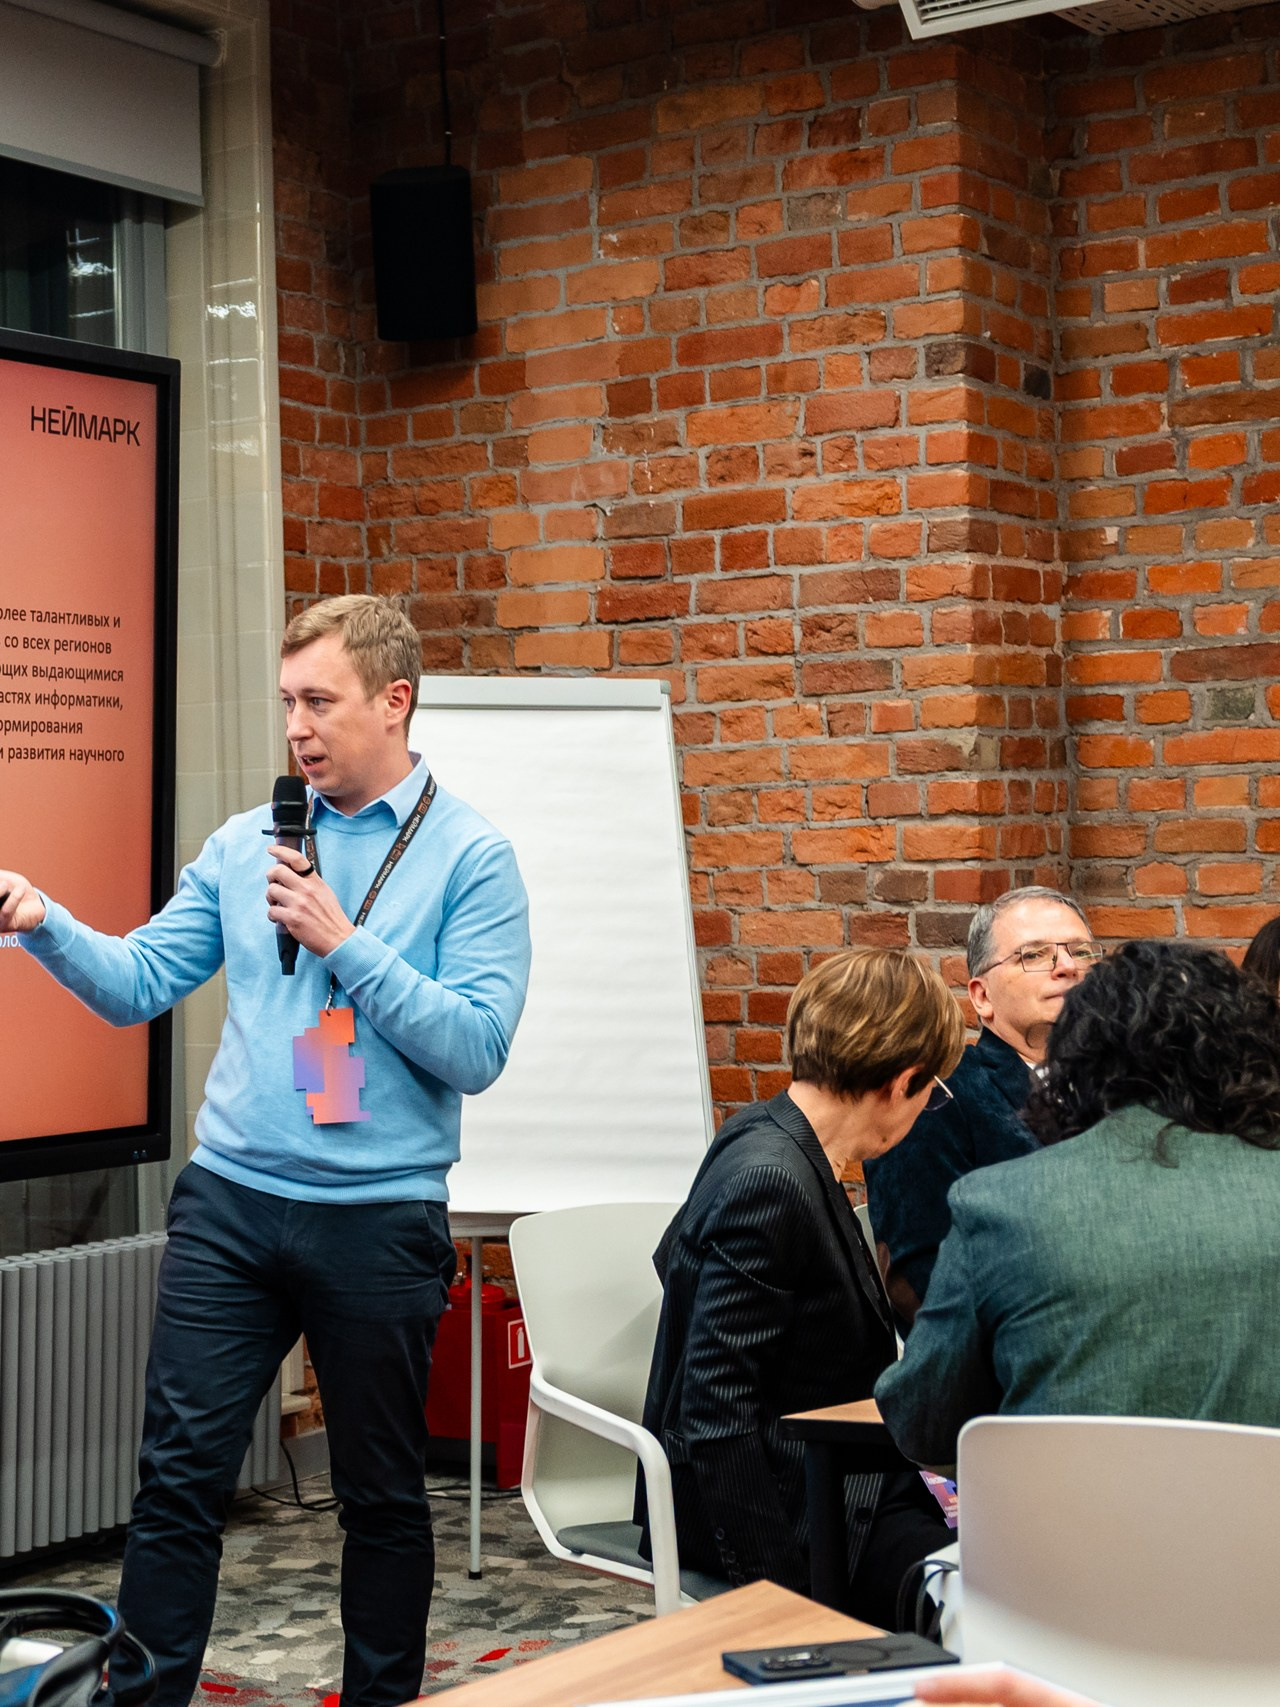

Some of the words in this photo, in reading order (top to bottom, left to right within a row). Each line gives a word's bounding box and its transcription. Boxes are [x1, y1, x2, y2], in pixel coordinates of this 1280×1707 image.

[30, 406, 140, 446] НЕЙМАРК
[29, 610, 109, 627] талантливых
[113, 617, 120, 628] и
[4, 636, 18, 648] со
[22, 637, 50, 650] всех
[53, 639, 111, 654] регионов
[31, 666, 123, 683] выдающимися
[34, 690, 123, 711] информатики,
[7, 748, 65, 763] развития
[69, 749, 124, 765] научного
